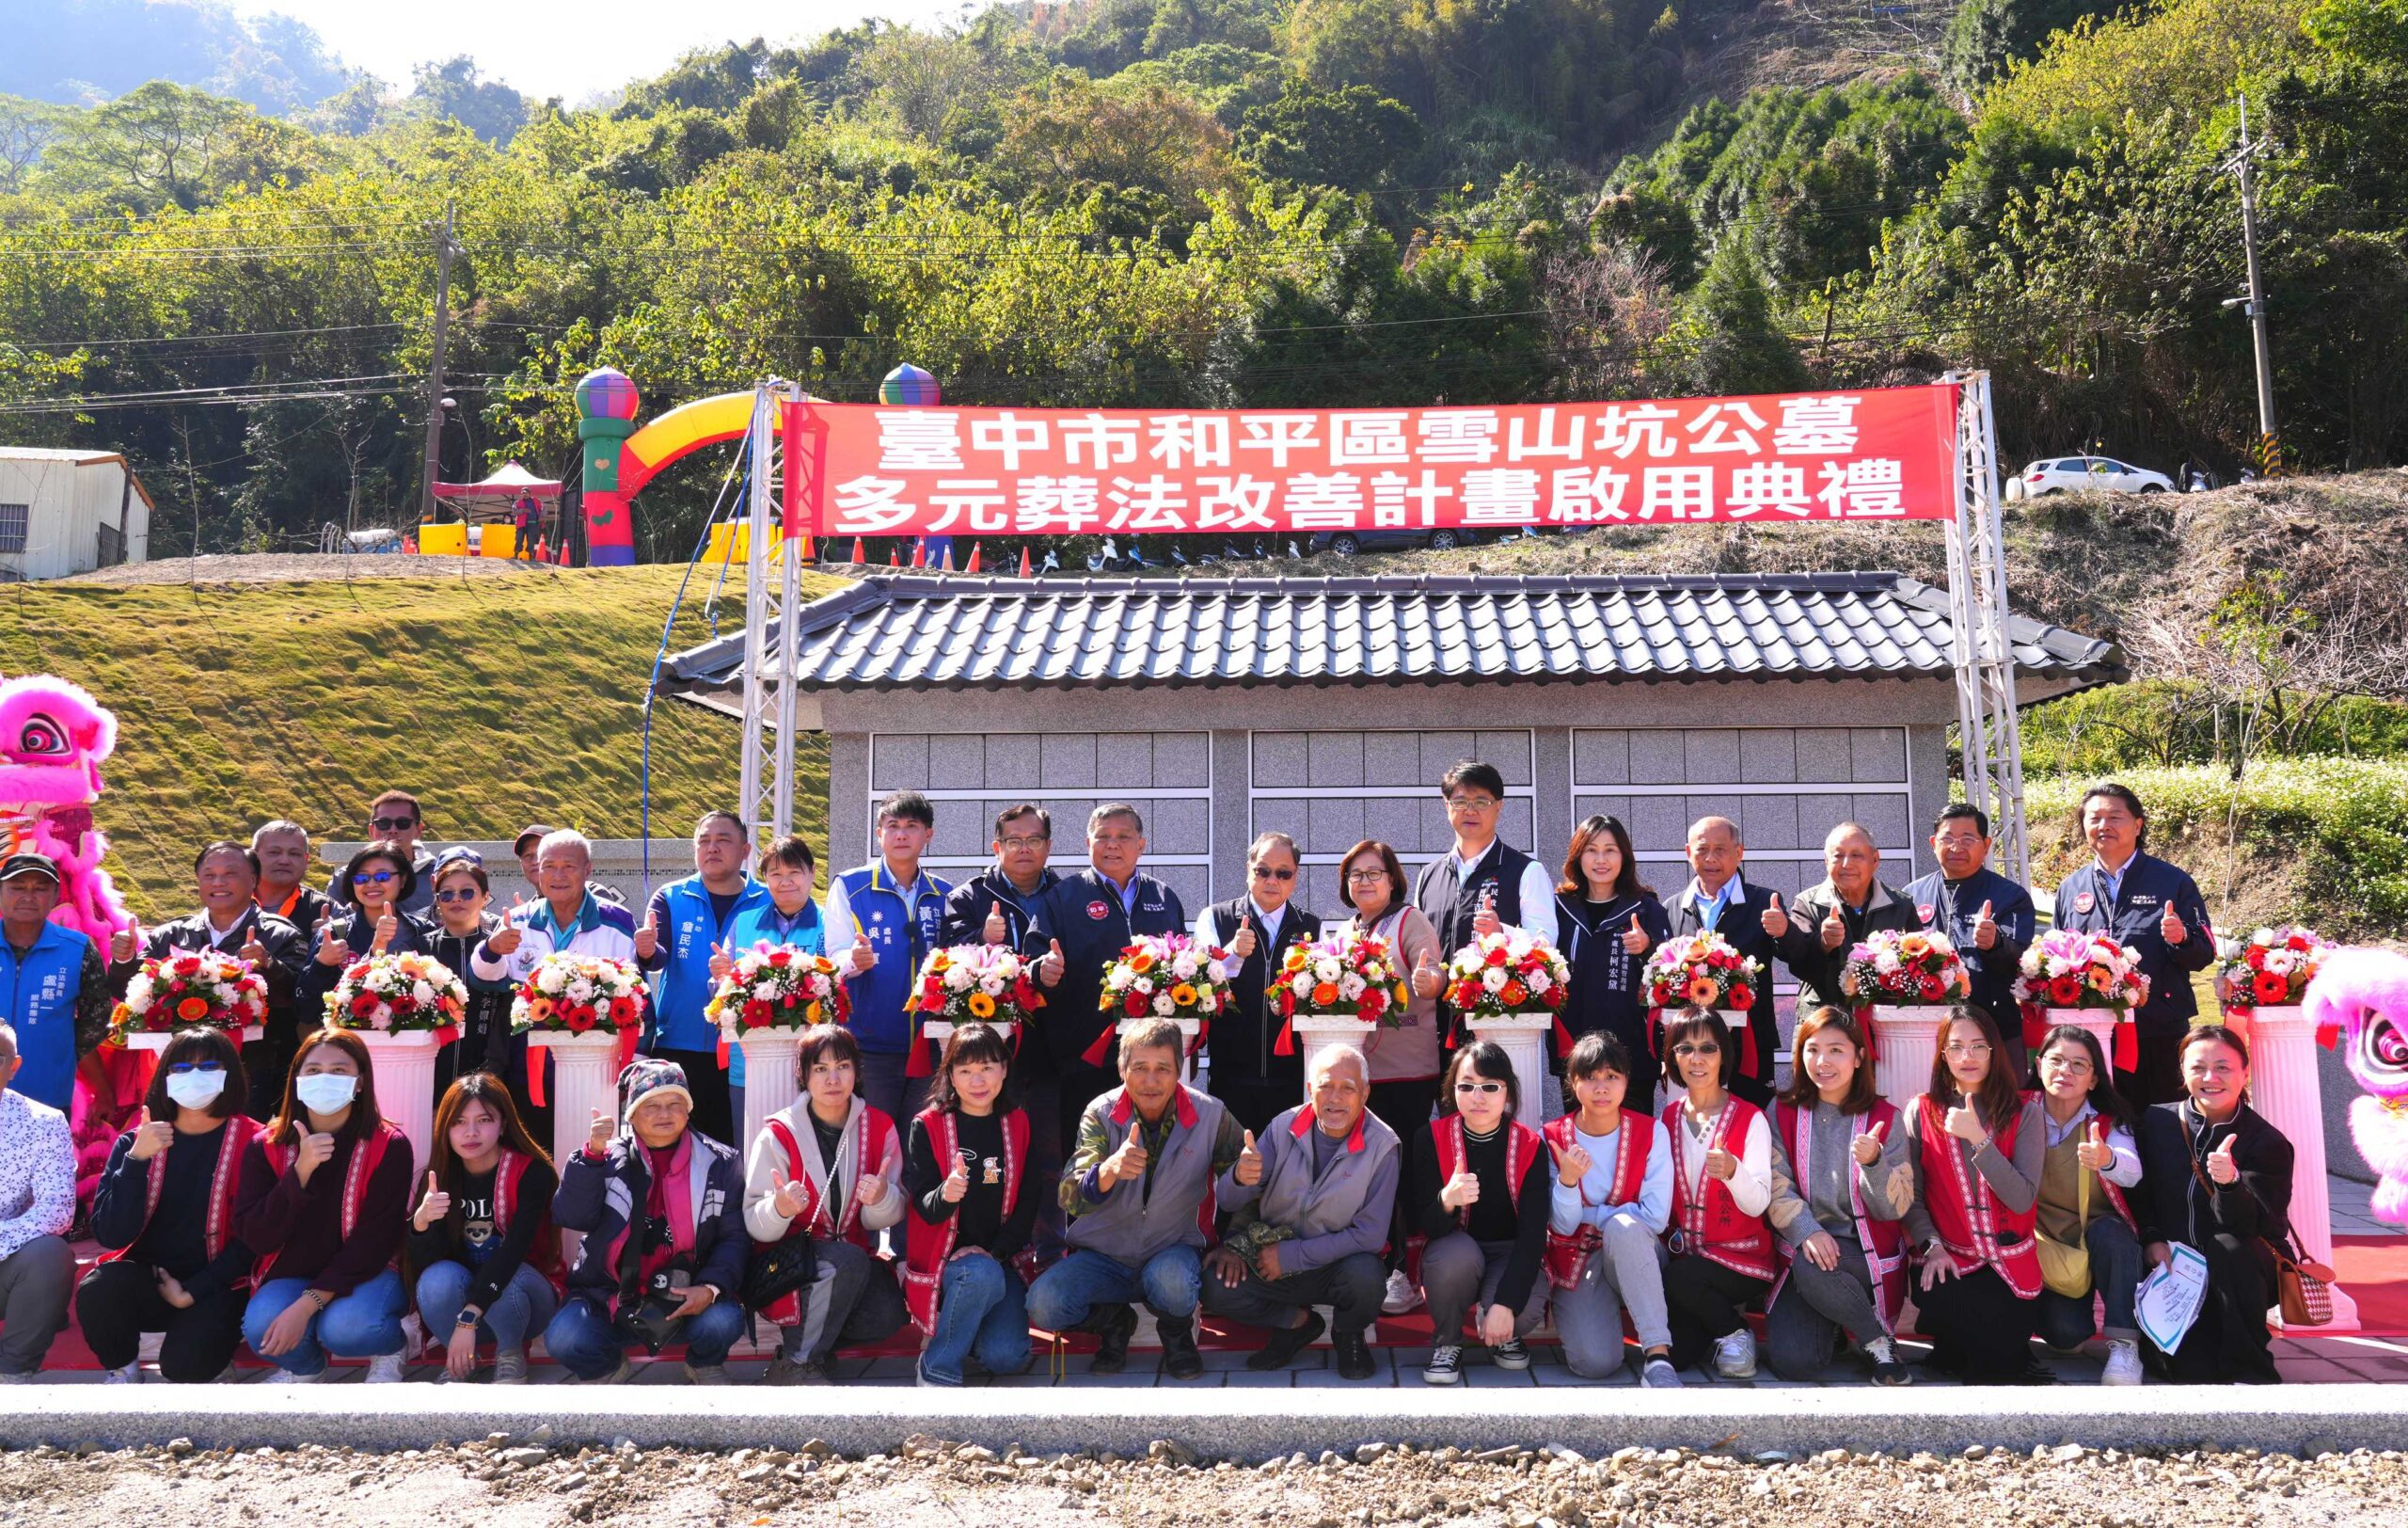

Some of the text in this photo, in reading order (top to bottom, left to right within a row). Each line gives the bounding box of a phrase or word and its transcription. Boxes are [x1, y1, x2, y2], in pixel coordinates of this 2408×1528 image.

[874, 395, 1861, 471] 臺中市和平區雪山坑公墓
[834, 458, 1906, 533] 多元葬法改善計畫啟用典禮
